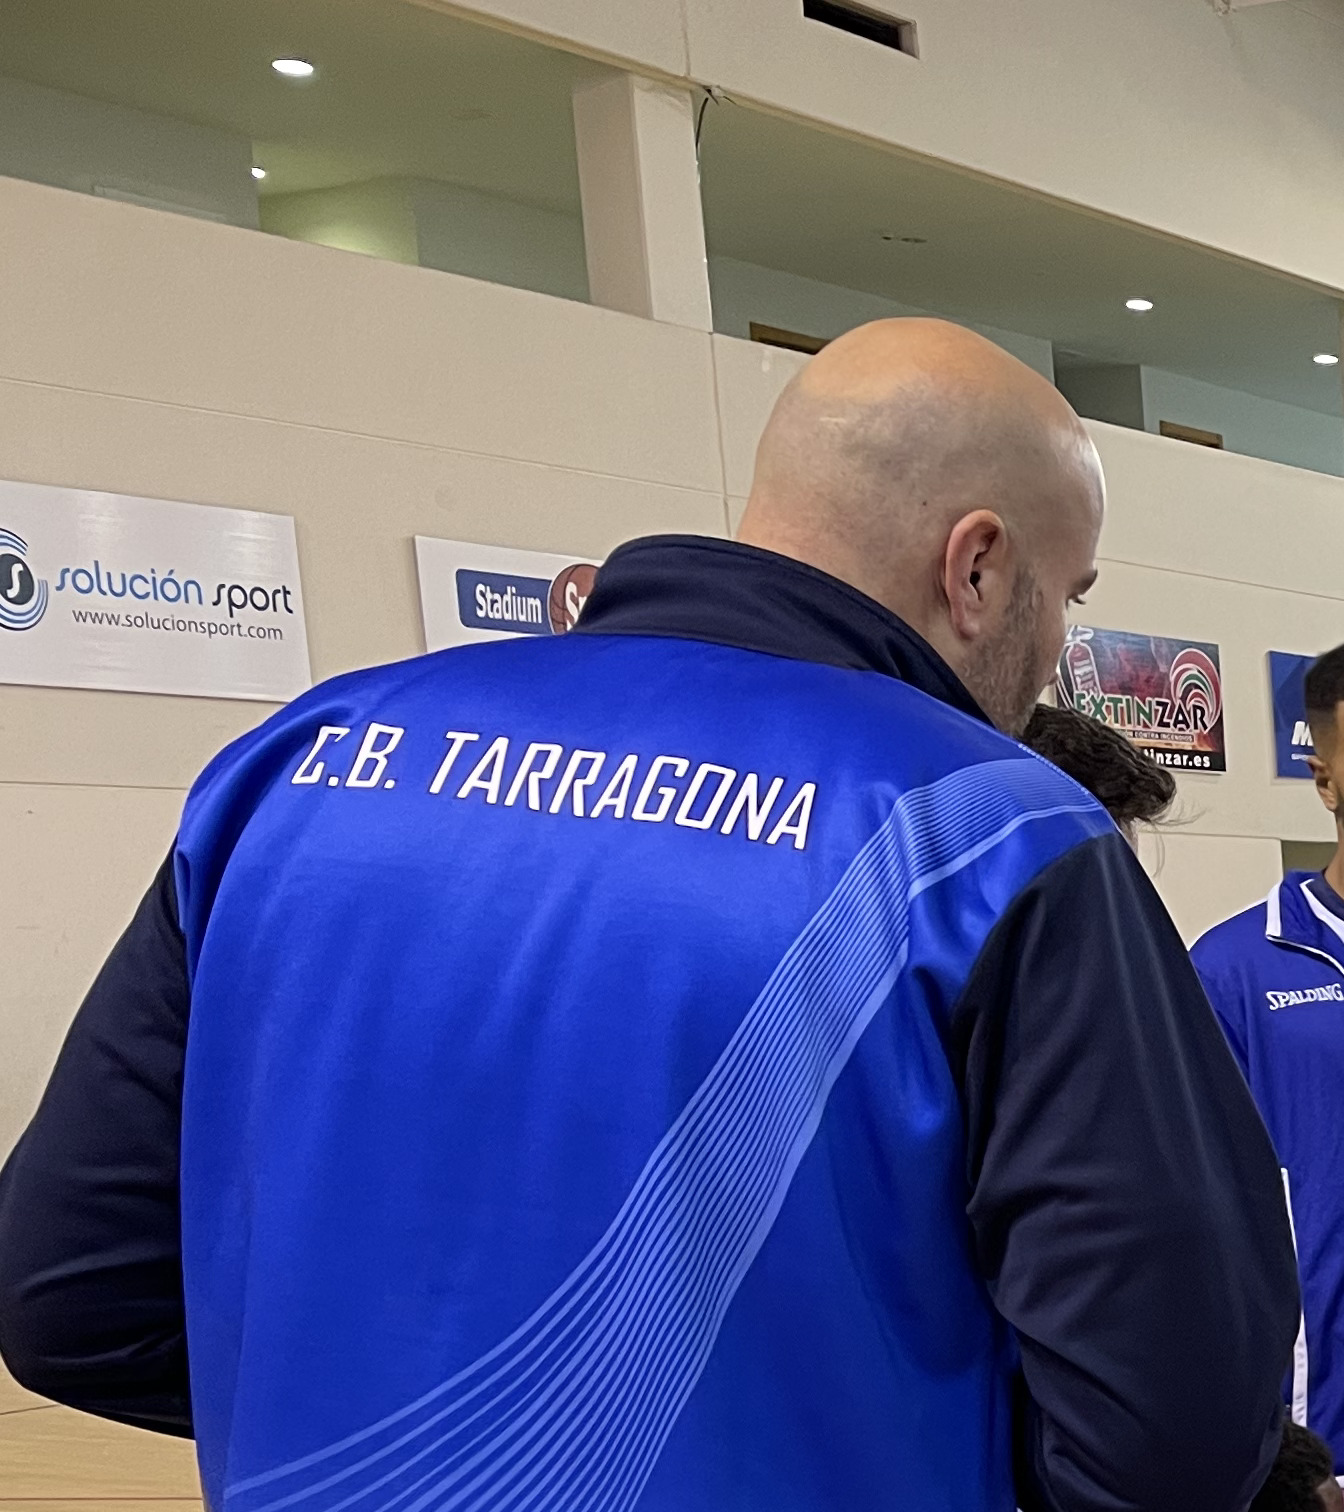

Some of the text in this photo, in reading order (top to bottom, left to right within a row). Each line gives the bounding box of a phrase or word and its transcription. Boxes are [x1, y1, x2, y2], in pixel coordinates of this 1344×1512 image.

[54, 559, 294, 618] solución sport
[475, 583, 542, 624] Stadium
[71, 609, 284, 641] www.solucionsport.com
[291, 720, 818, 851] C.B. TARRAGONA
[1265, 983, 1344, 1011] SPALDING
